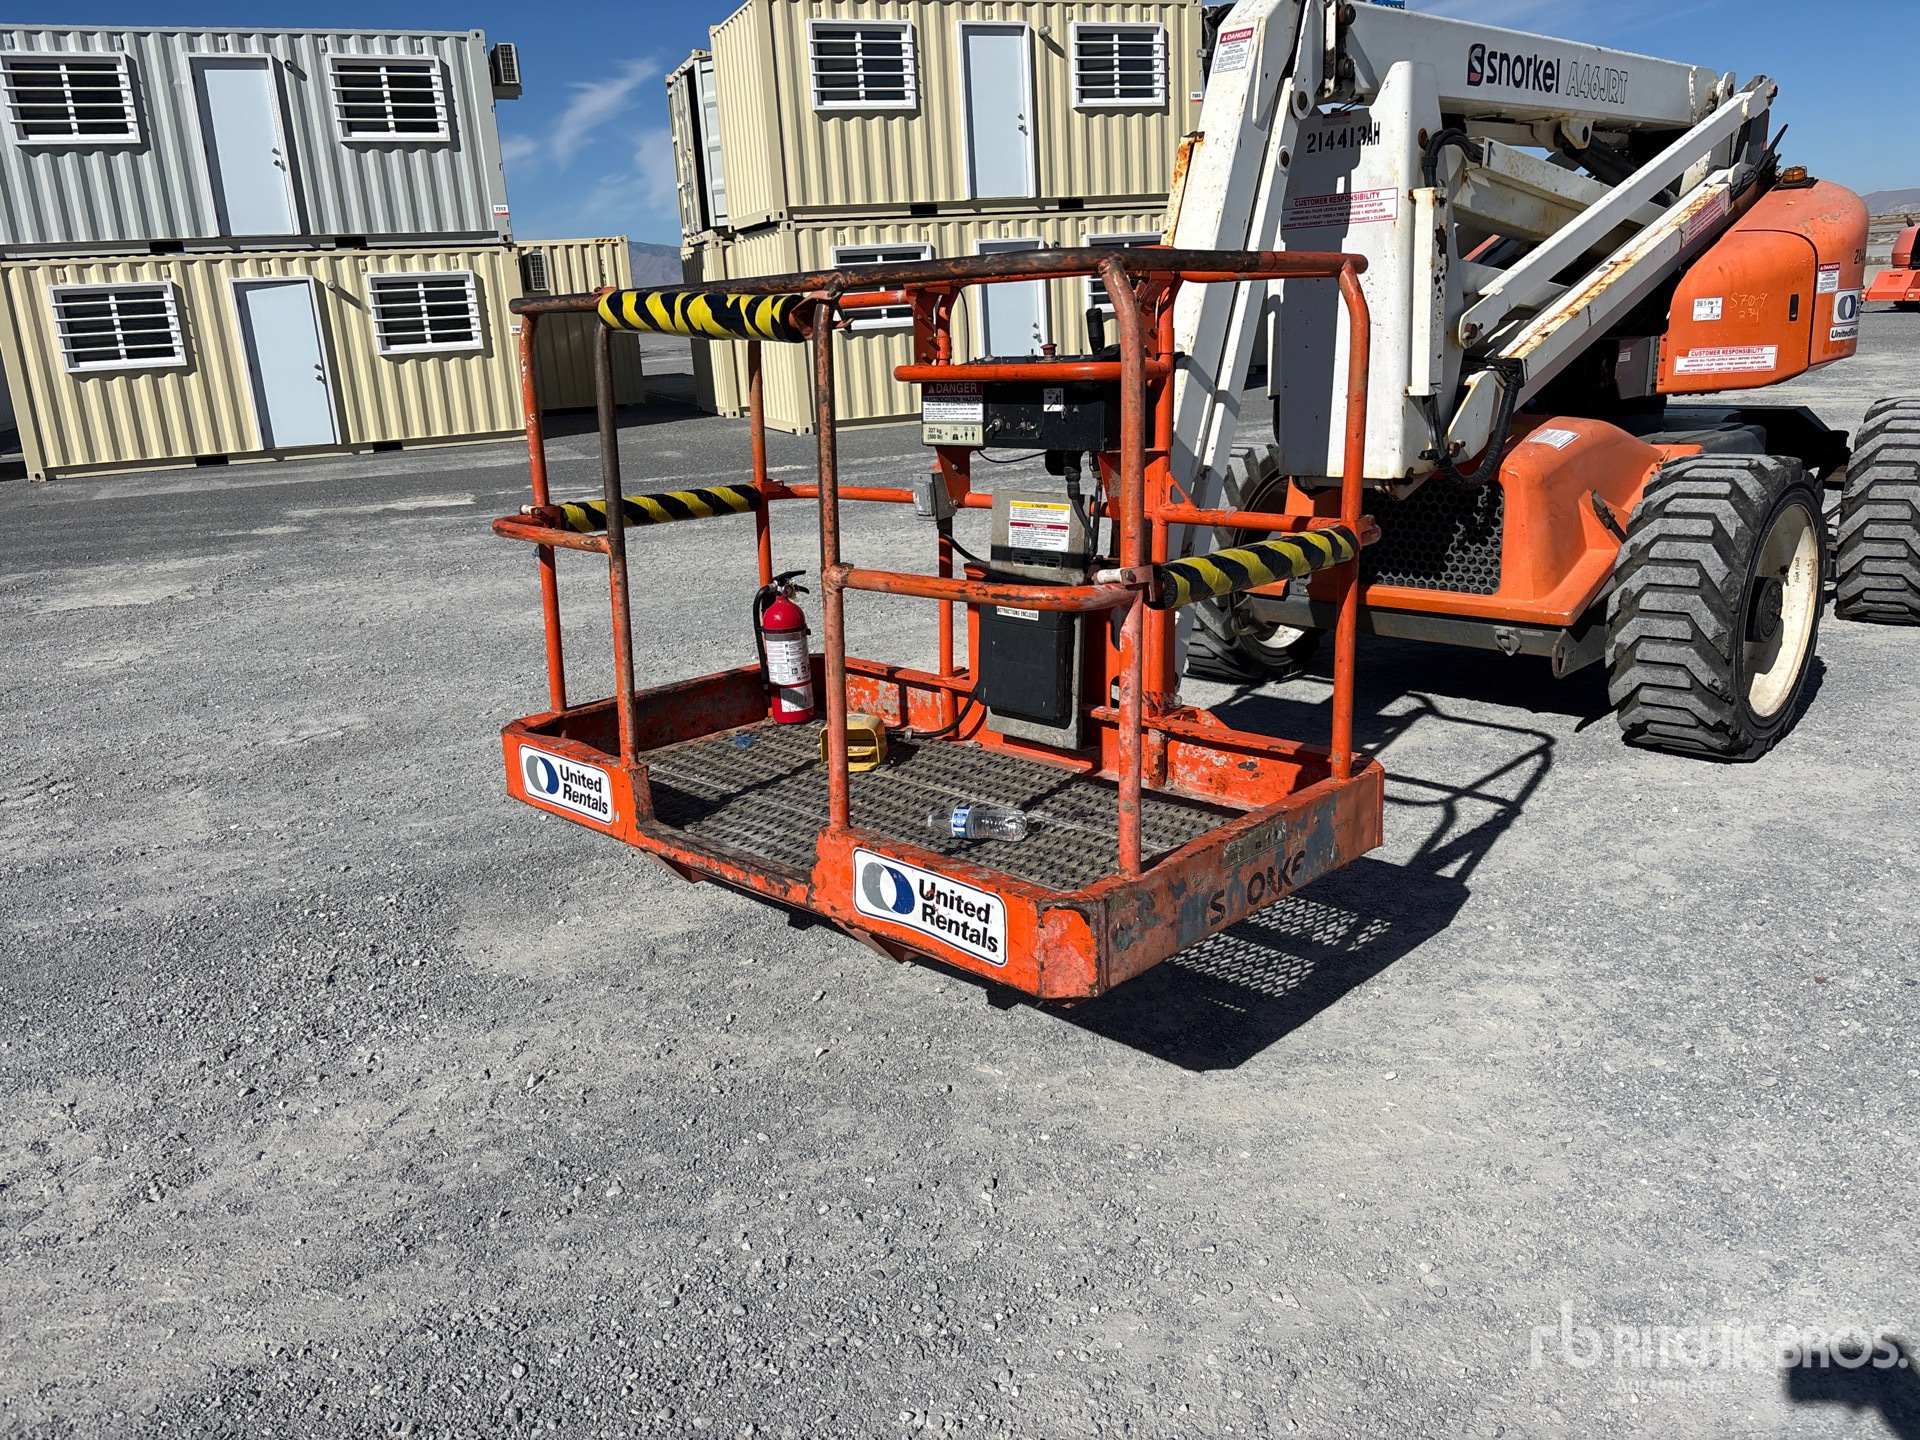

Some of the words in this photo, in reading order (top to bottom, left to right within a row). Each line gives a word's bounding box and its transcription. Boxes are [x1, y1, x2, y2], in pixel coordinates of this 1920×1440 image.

[1226, 30, 1252, 41] DANGER
[1486, 51, 1560, 93] snorkel
[1565, 61, 1628, 104] A46JRT
[1306, 121, 1380, 153] 214413AH
[1294, 197, 1328, 207] CUSTOMER
[1330, 192, 1380, 203] RESPONSIBILITY
[936, 382, 976, 394] DANGER
[560, 764, 602, 793] United
[563, 783, 608, 814] Rentals
[918, 878, 991, 924] United
[922, 903, 998, 952] Rentals
